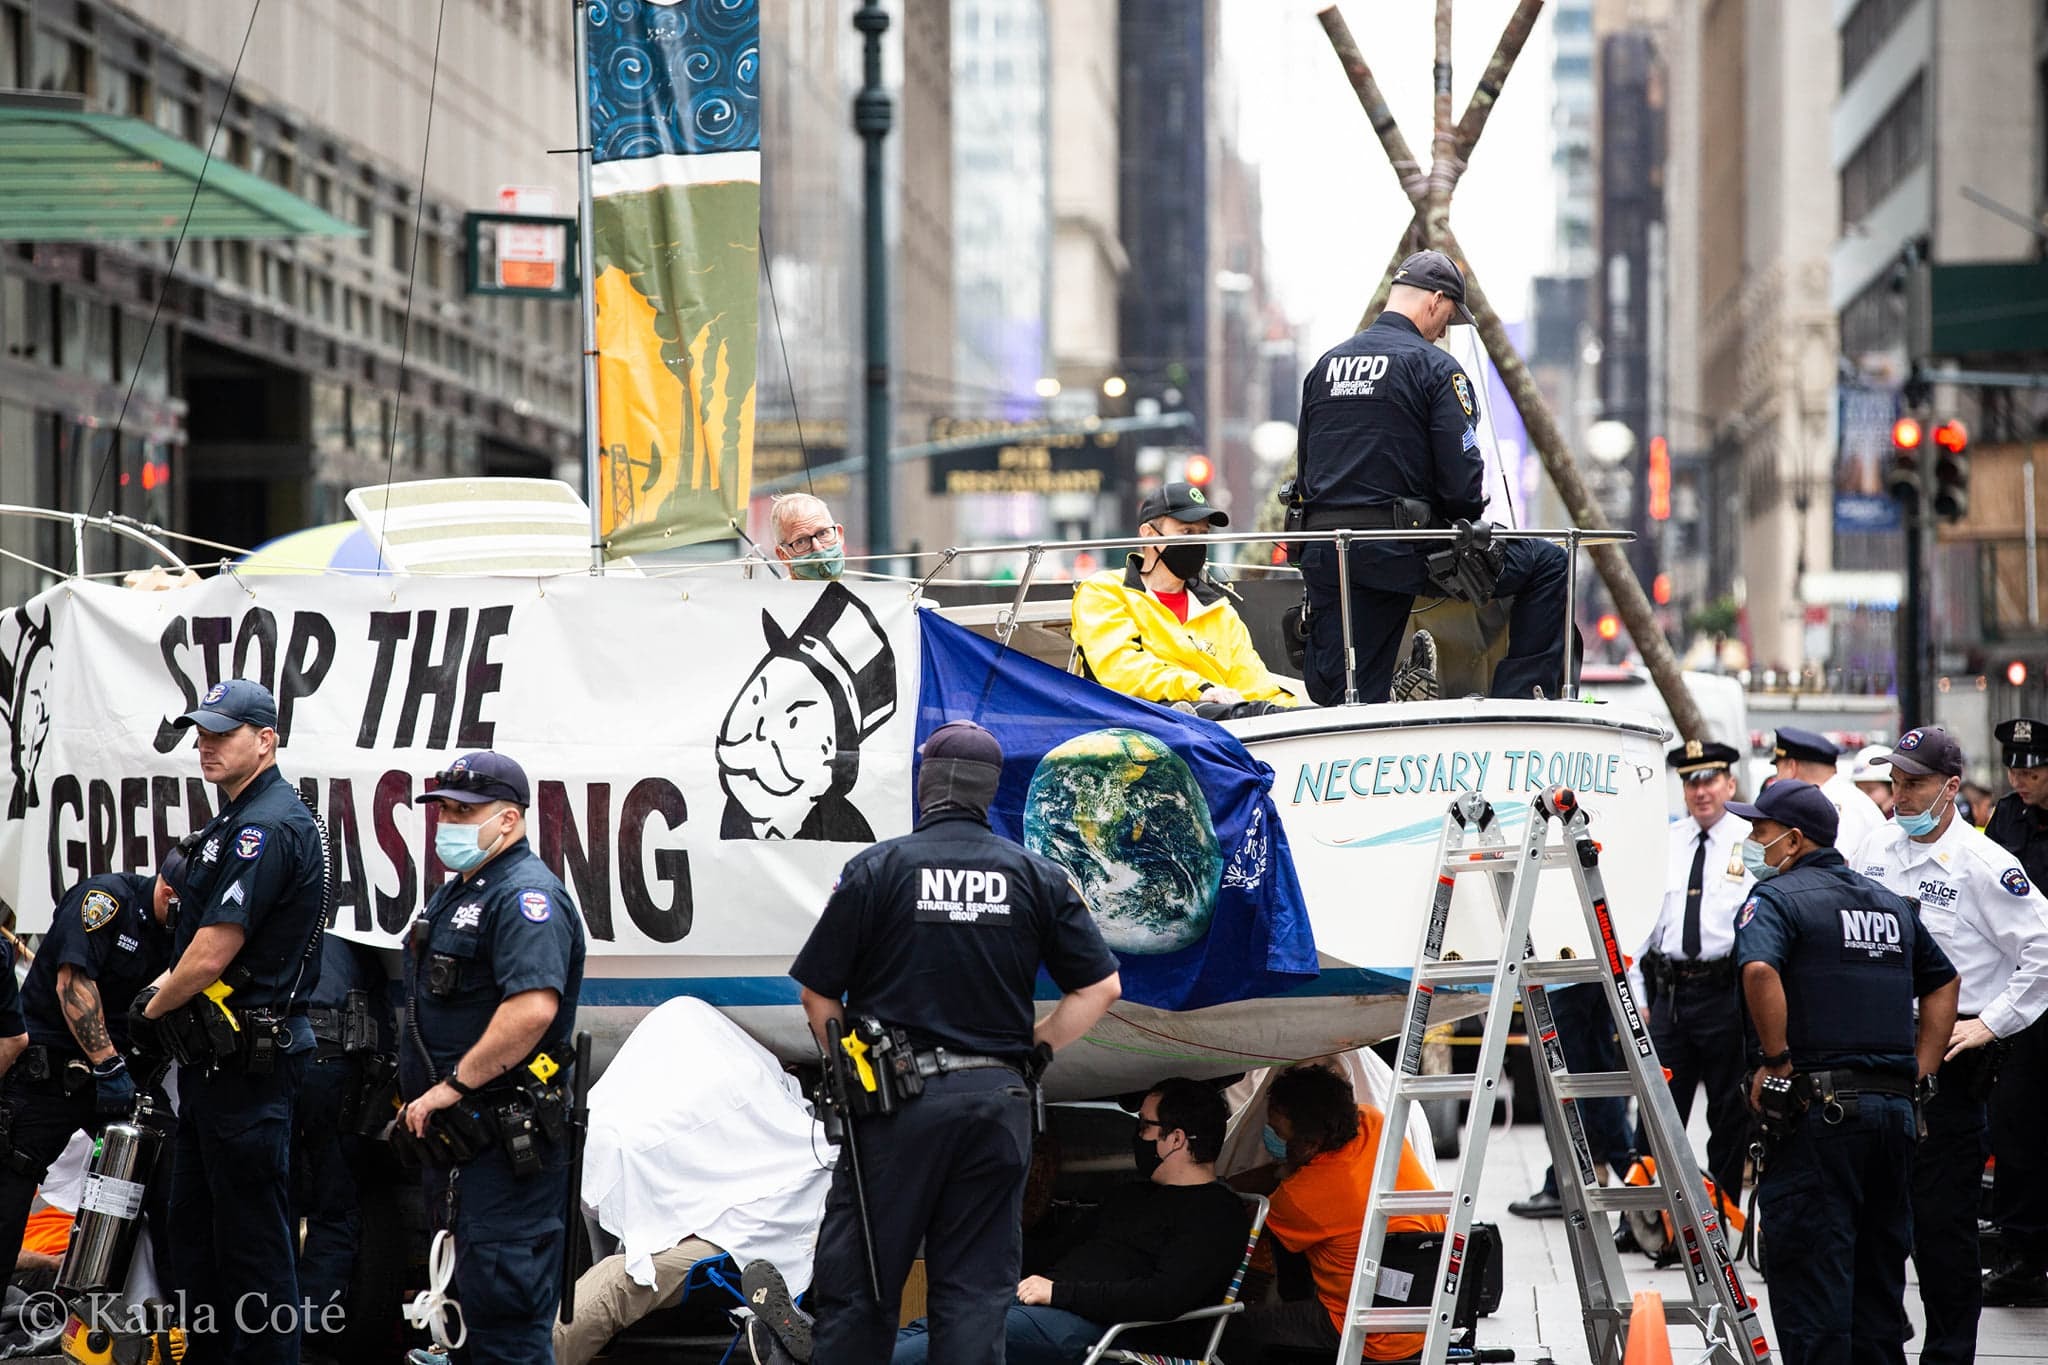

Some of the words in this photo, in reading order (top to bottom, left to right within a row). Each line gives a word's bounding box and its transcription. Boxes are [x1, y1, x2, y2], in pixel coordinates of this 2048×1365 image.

[1326, 356, 1389, 382] NYPD
[1330, 388, 1357, 396] SERVICE
[1358, 387, 1375, 395] UNIT
[1333, 380, 1373, 389] EMERGENCY
[153, 606, 337, 754] STOP
[356, 605, 514, 750] THE
[1292, 751, 1491, 804] NECESSARY
[1505, 750, 1620, 795] TROUBLE
[921, 868, 1007, 904] NYPD
[1918, 880, 1958, 901] POLICE
[917, 900, 964, 912] STRATEGIC
[966, 902, 1011, 915] RESPONSE
[949, 911, 979, 922] GROUP
[1840, 910, 1900, 944] NYPD
[1595, 903, 1611, 939] Little
[1605, 939, 1623, 976] Giant
[1844, 940, 1876, 951] DISORDER
[1877, 943, 1903, 953] CONTROL
[1868, 950, 1883, 958] UNIT
[1617, 981, 1640, 1031] LEVELER
